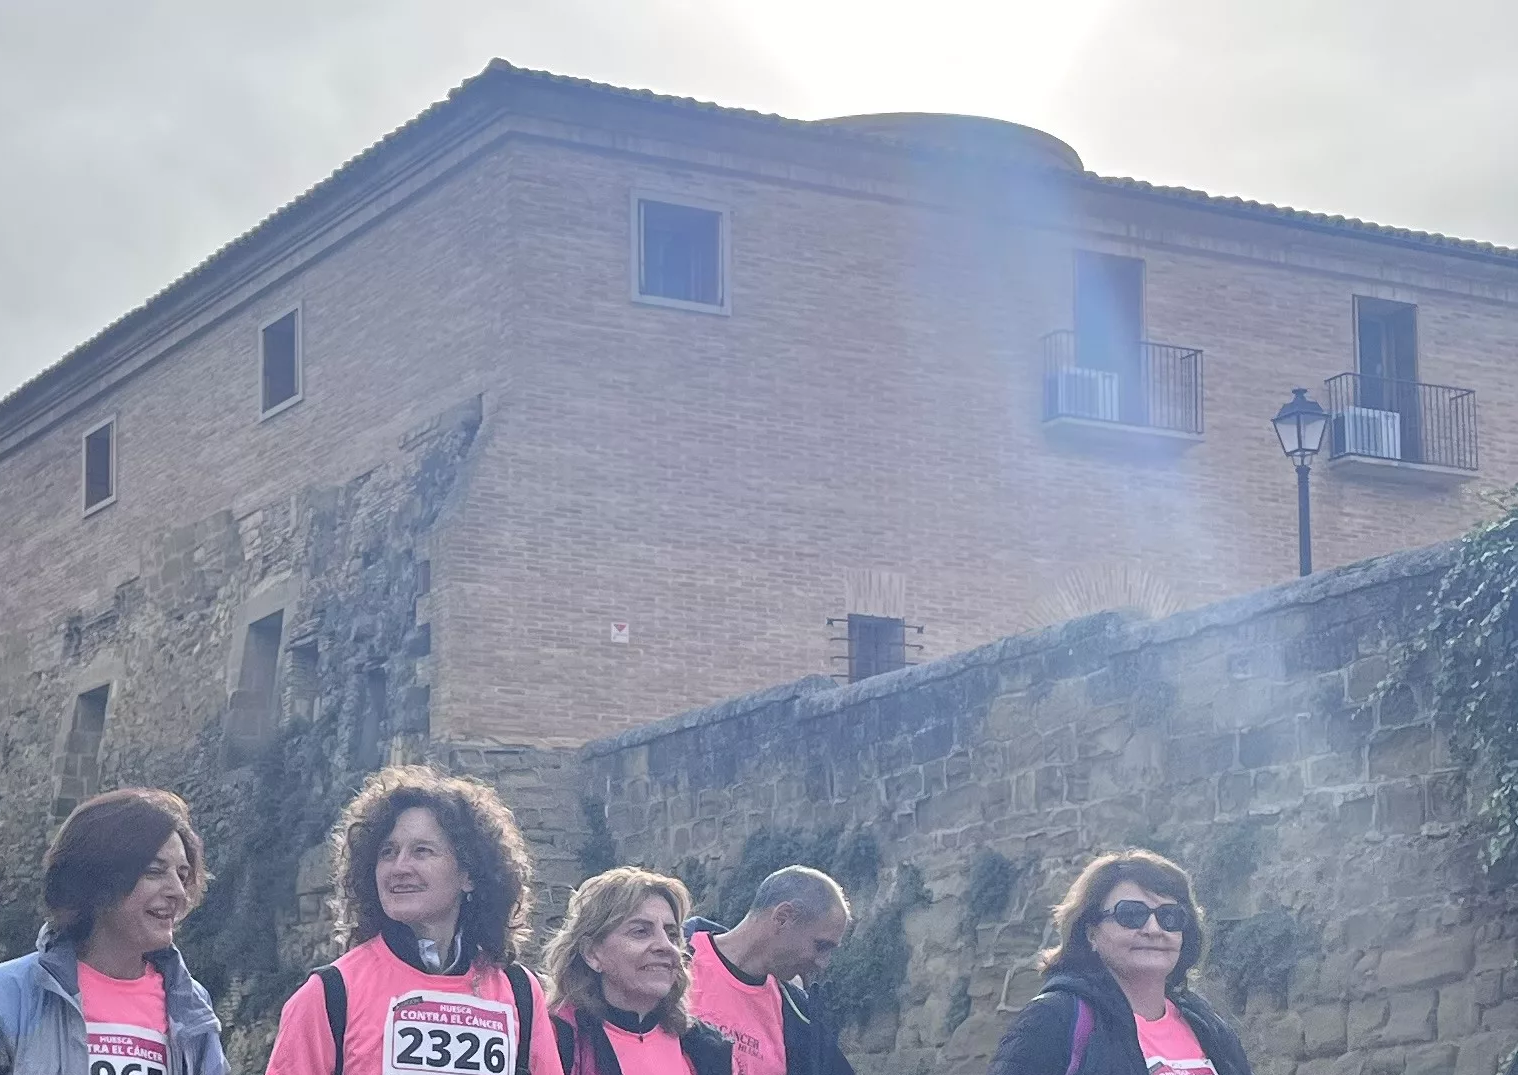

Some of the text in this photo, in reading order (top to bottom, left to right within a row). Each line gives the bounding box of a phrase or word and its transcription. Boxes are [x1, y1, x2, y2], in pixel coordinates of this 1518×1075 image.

[439, 1004, 472, 1015] HUESCA
[400, 1010, 449, 1023] CONTRA
[450, 1014, 464, 1025] EL
[99, 1035, 133, 1045] HUESCA
[86, 1043, 163, 1061] TRA EL CÁNCER
[396, 1026, 506, 1074] 2326
